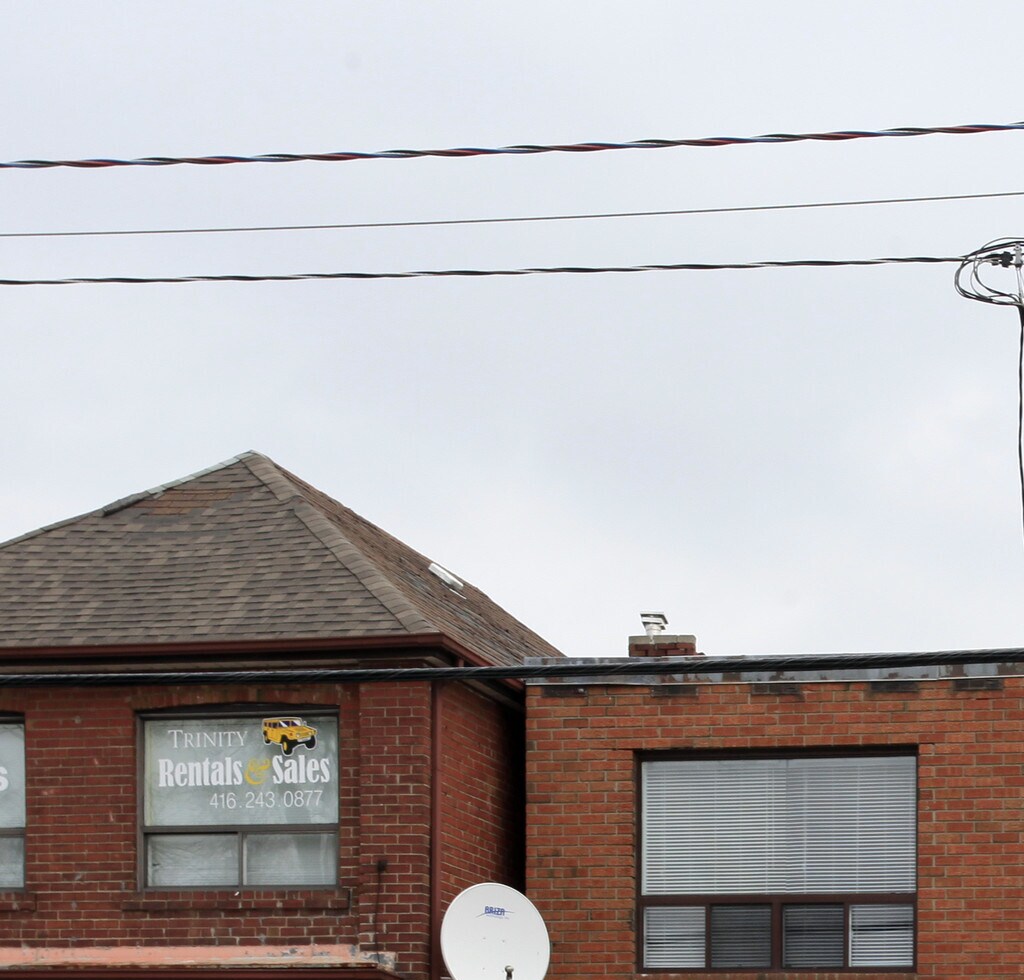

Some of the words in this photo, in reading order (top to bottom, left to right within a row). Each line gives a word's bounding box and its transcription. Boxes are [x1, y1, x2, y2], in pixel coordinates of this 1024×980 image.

[168, 730, 248, 748] TRINITY
[158, 757, 243, 787] Rentals
[272, 755, 330, 784] Sales
